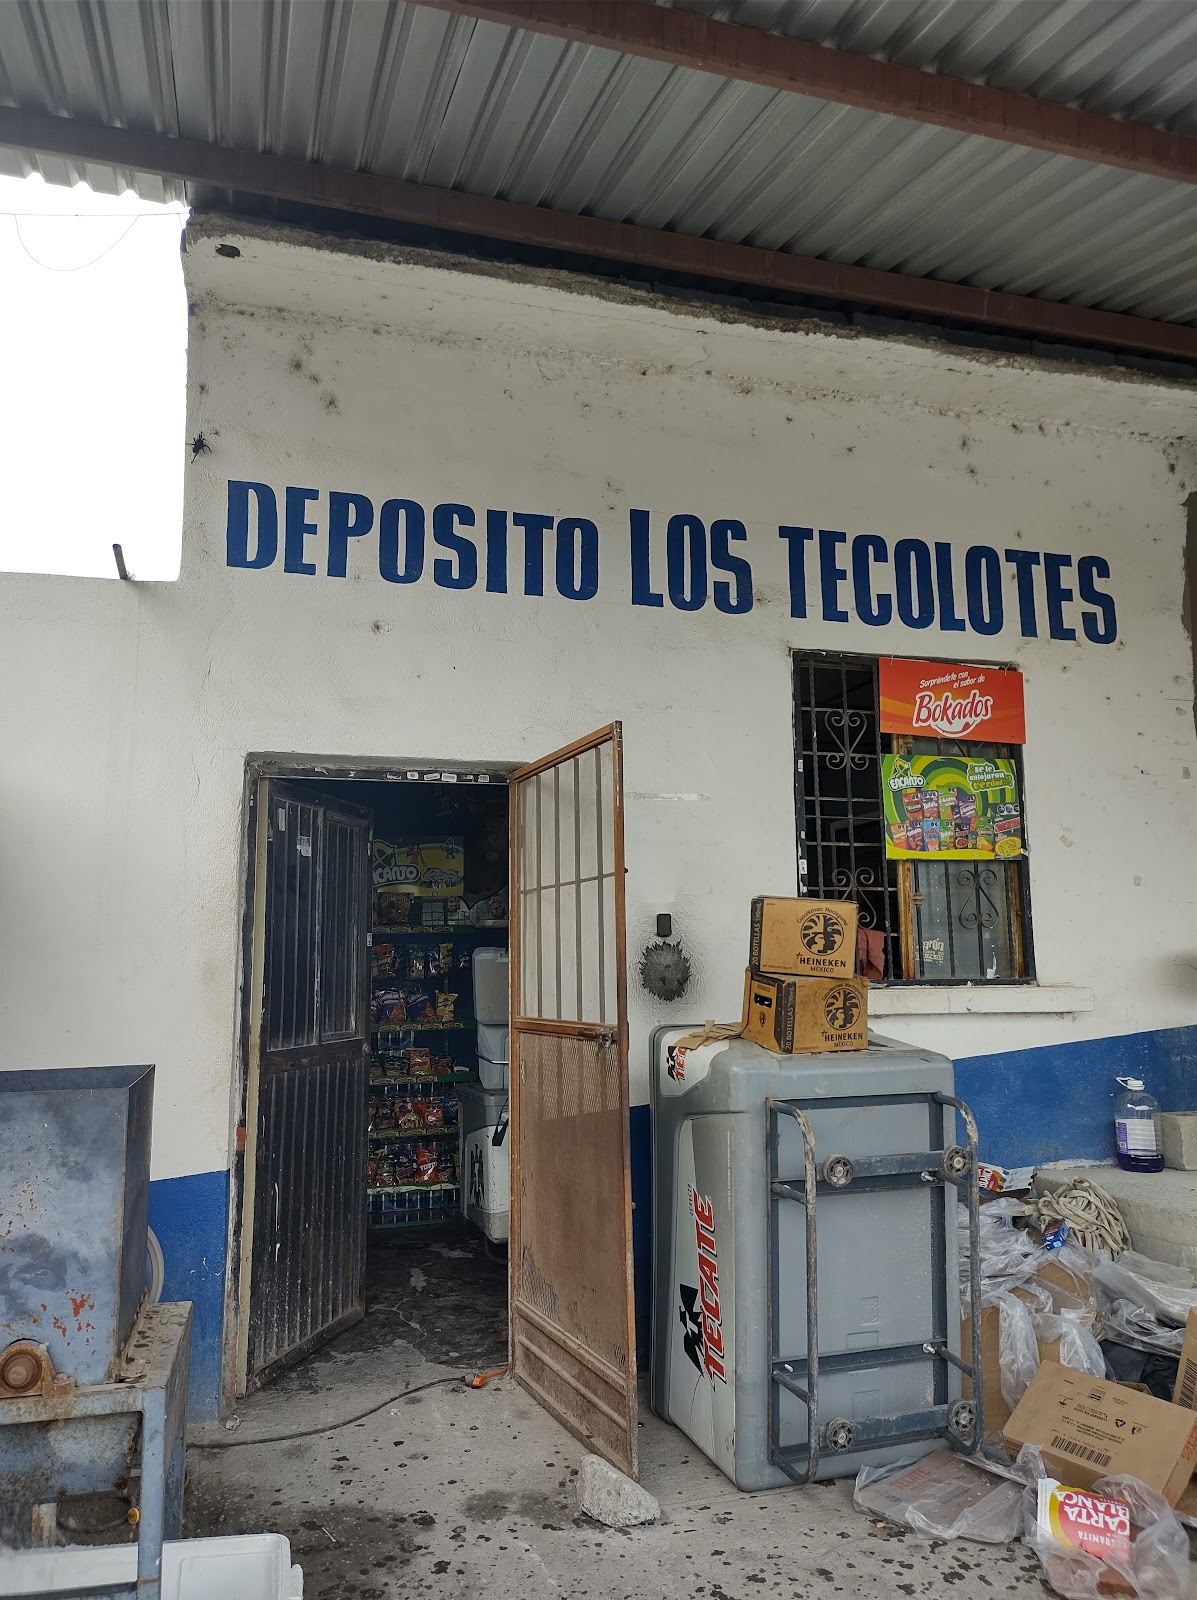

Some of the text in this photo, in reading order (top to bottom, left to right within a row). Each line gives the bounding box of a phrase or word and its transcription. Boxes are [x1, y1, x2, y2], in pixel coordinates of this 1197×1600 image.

[226, 479, 1118, 645] DEPOSITO LOS TECOLOTES
[920, 671, 969, 688] Sorpréndete con
[953, 673, 986, 689] el sabor de
[914, 691, 992, 726] Bokados
[985, 765, 993, 773] te
[889, 777, 924, 790] ENCANTO
[753, 923, 761, 956] BOTELLAS
[752, 956, 759, 965] 20
[800, 957, 847, 968] HEINEKEN
[786, 1007, 794, 1040] BOTELLAS
[785, 1041, 792, 1050] 20
[824, 1032, 863, 1042] HEINEKEN
[692, 1187, 727, 1392] TECATE
[1052, 1489, 1130, 1520] BLANCA
[1063, 1505, 1131, 1536] CARTA
